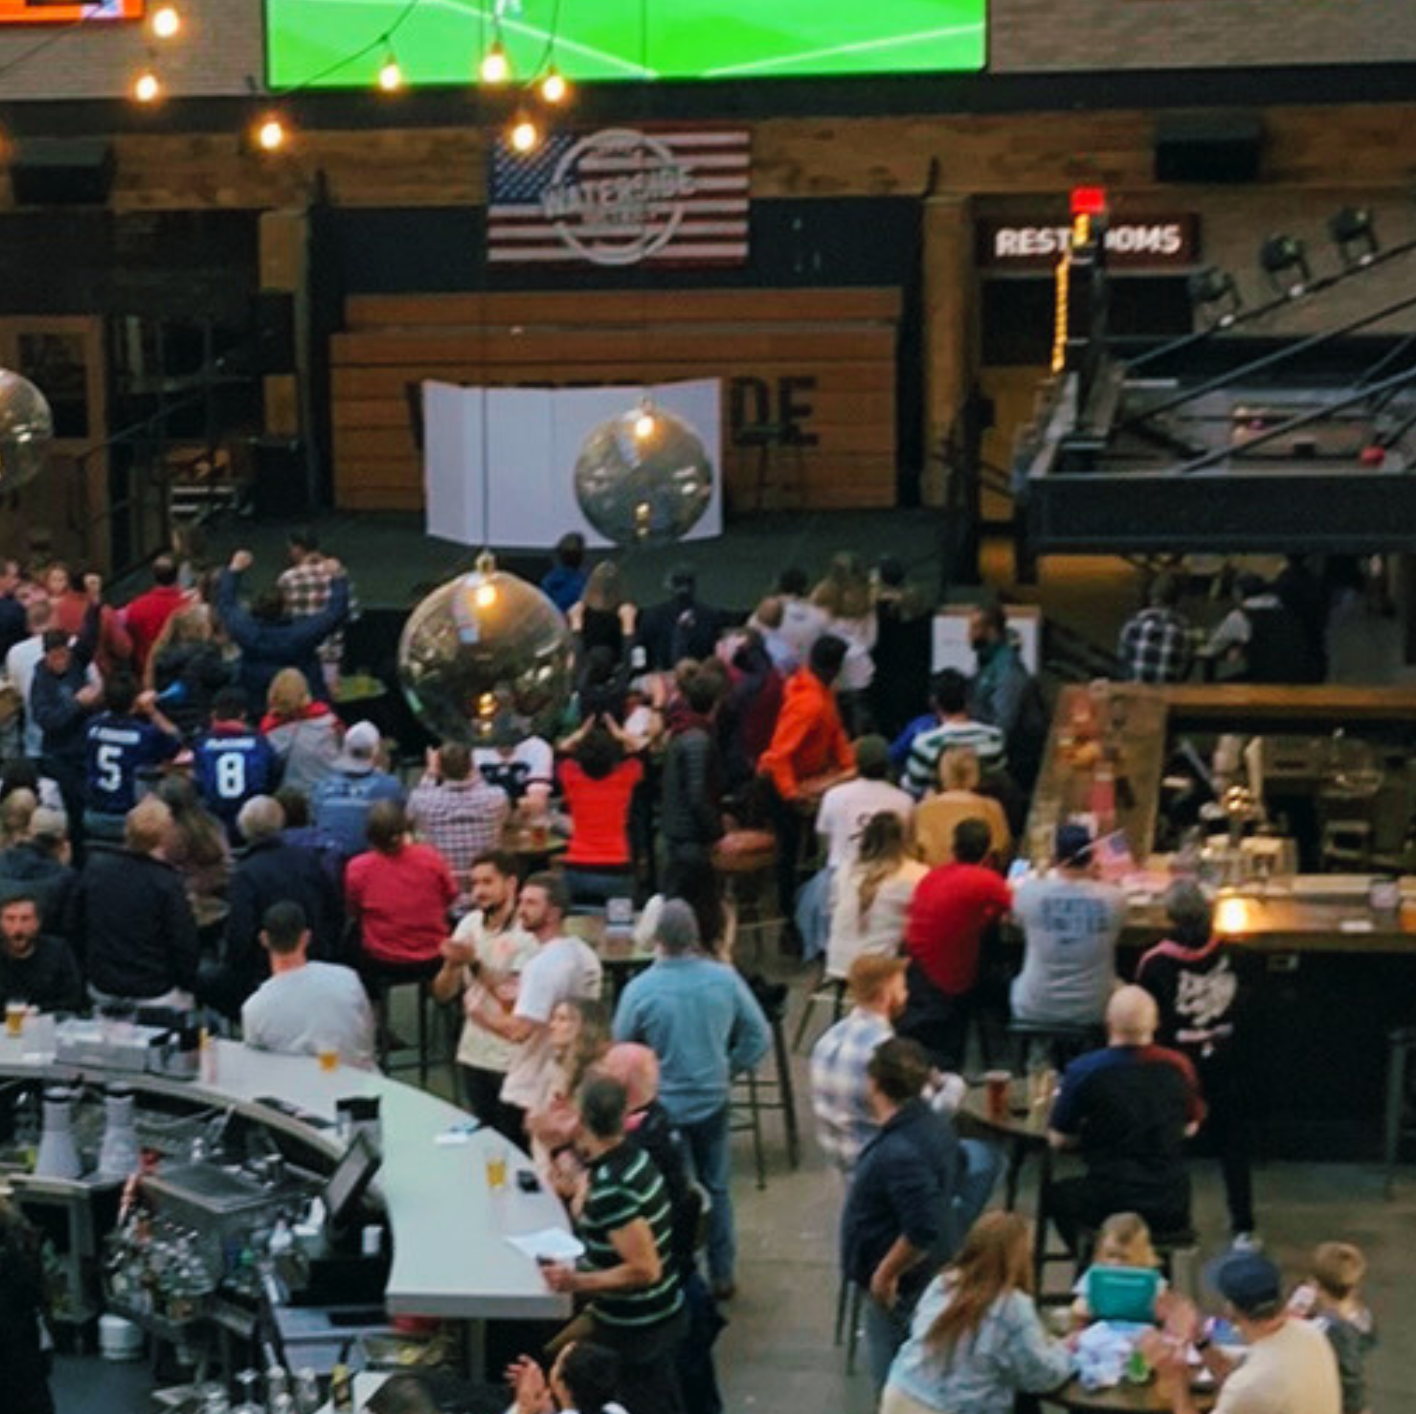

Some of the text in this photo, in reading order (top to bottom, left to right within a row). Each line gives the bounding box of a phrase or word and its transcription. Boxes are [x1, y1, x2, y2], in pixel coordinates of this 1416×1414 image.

[995, 224, 1182, 257] RESTOMS
[97, 744, 123, 792] 5
[216, 752, 246, 798] 8
